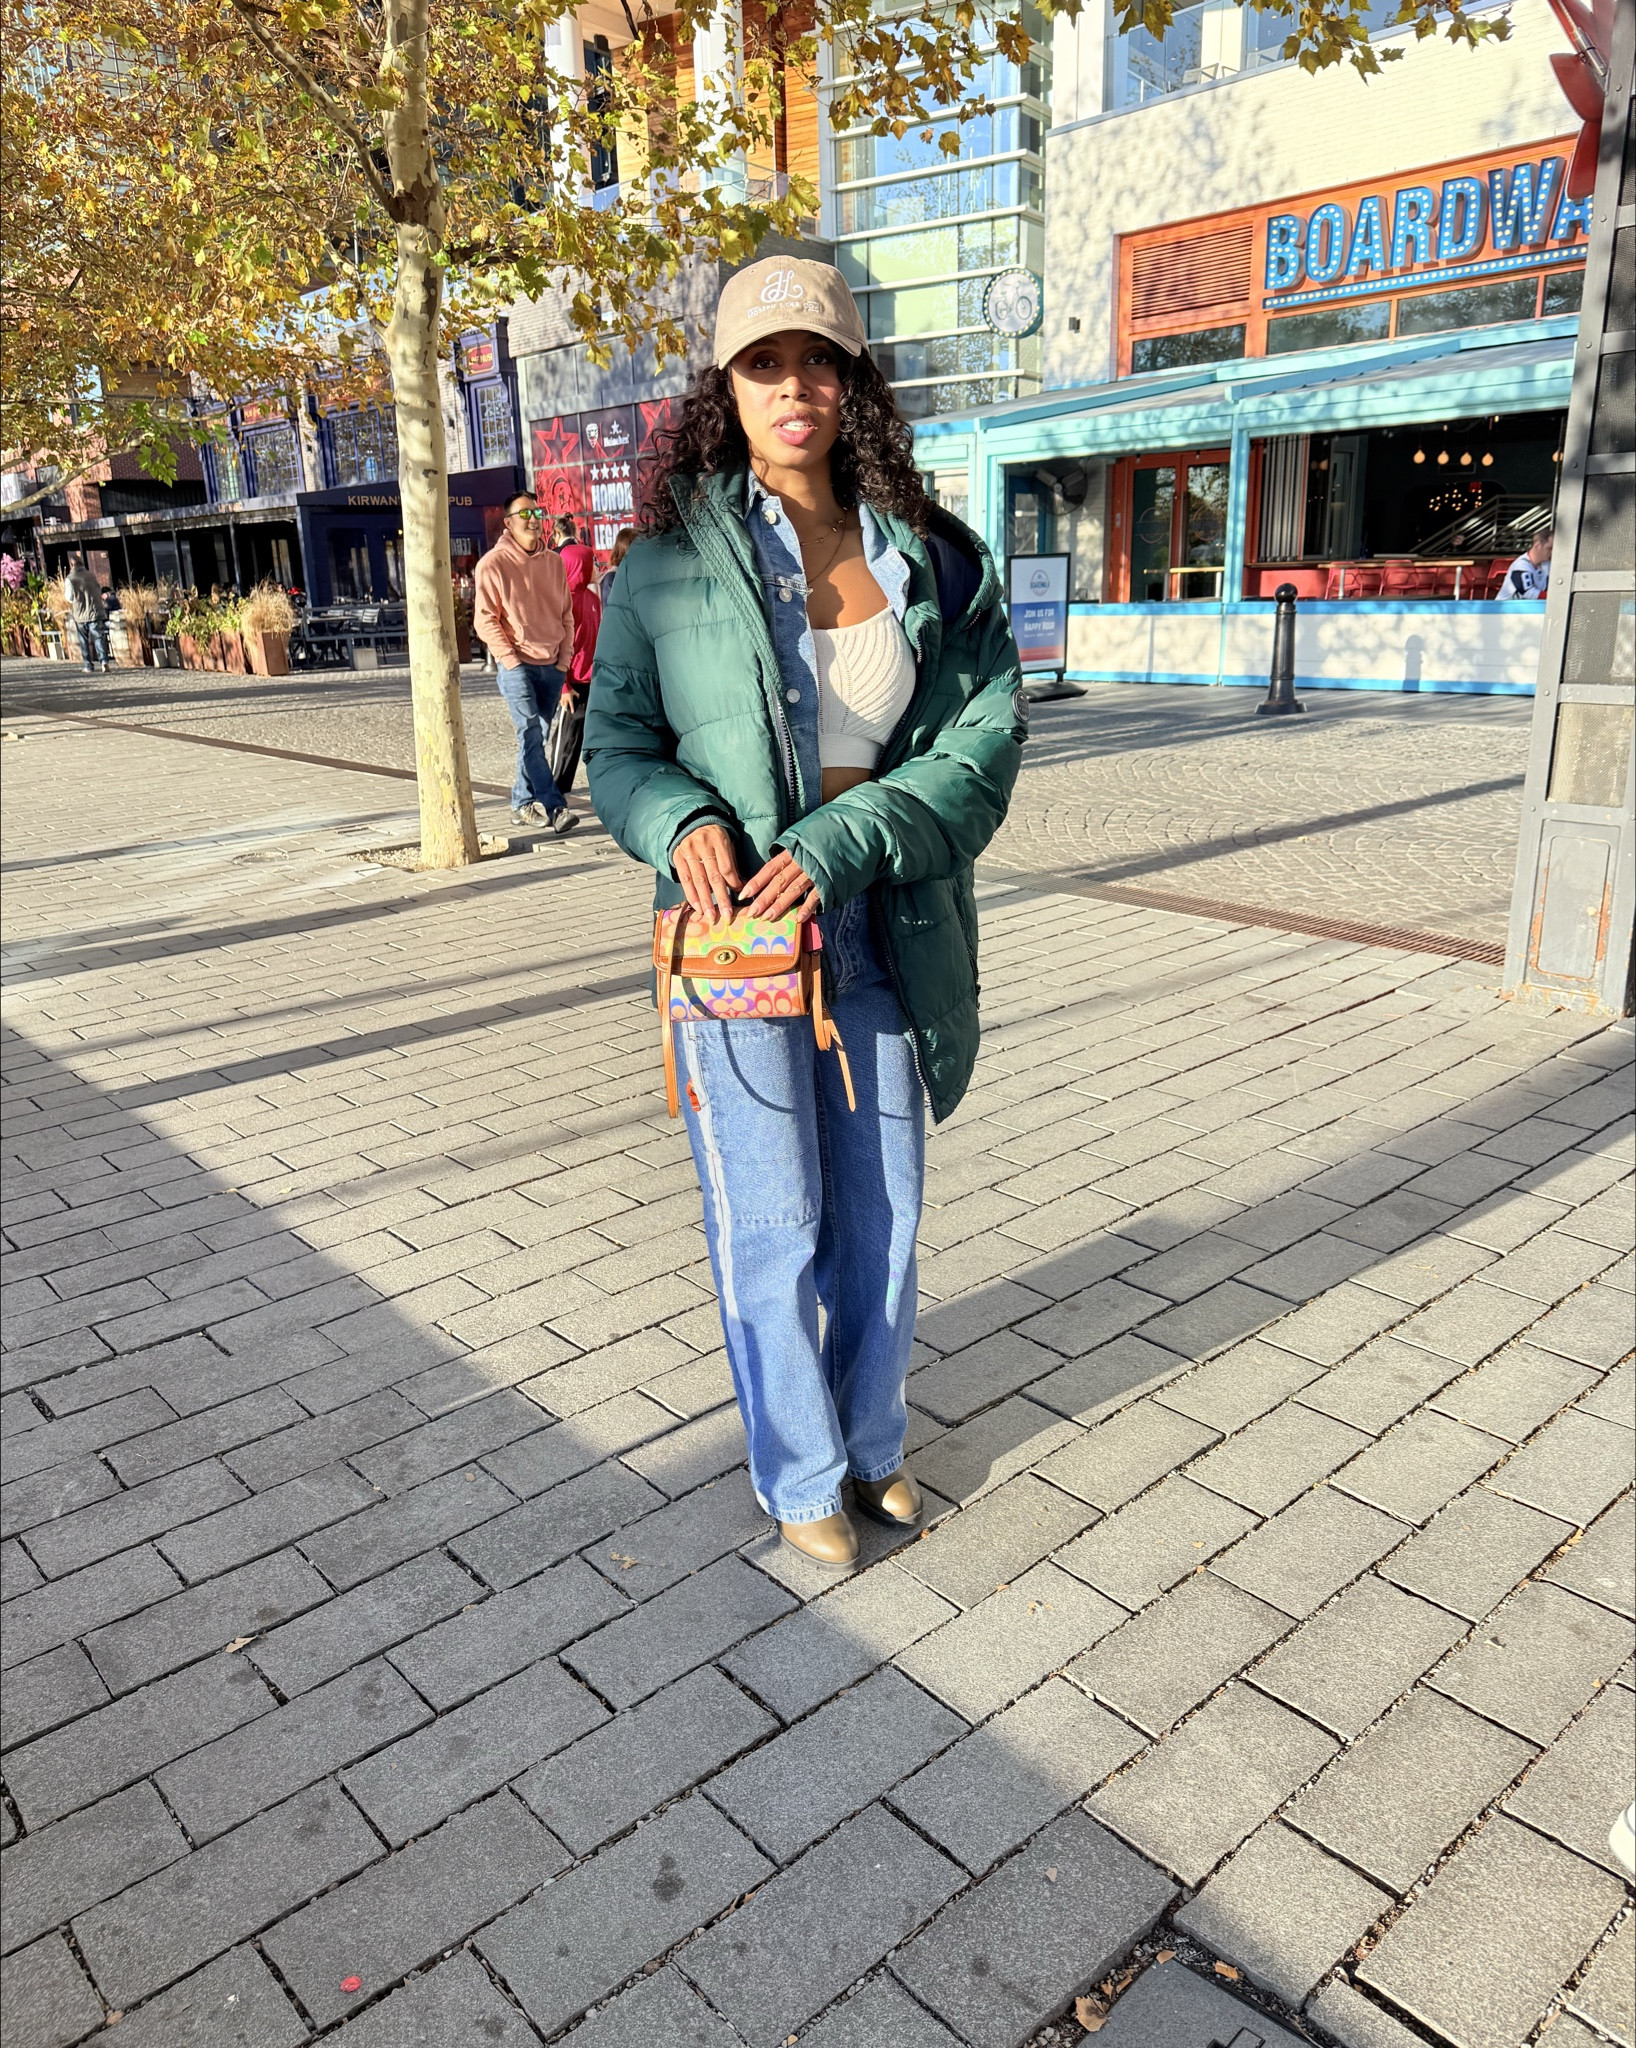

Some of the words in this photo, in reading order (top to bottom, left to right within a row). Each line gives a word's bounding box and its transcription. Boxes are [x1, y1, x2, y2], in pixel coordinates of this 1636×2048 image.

[449, 495, 473, 507] PUB
[591, 481, 634, 513] HONOR
[605, 513, 622, 522] THE
[1024, 609, 1036, 618] JOIN
[1037, 608, 1044, 617] US
[1045, 608, 1055, 617] FOR
[1024, 622, 1041, 631] HAPPY
